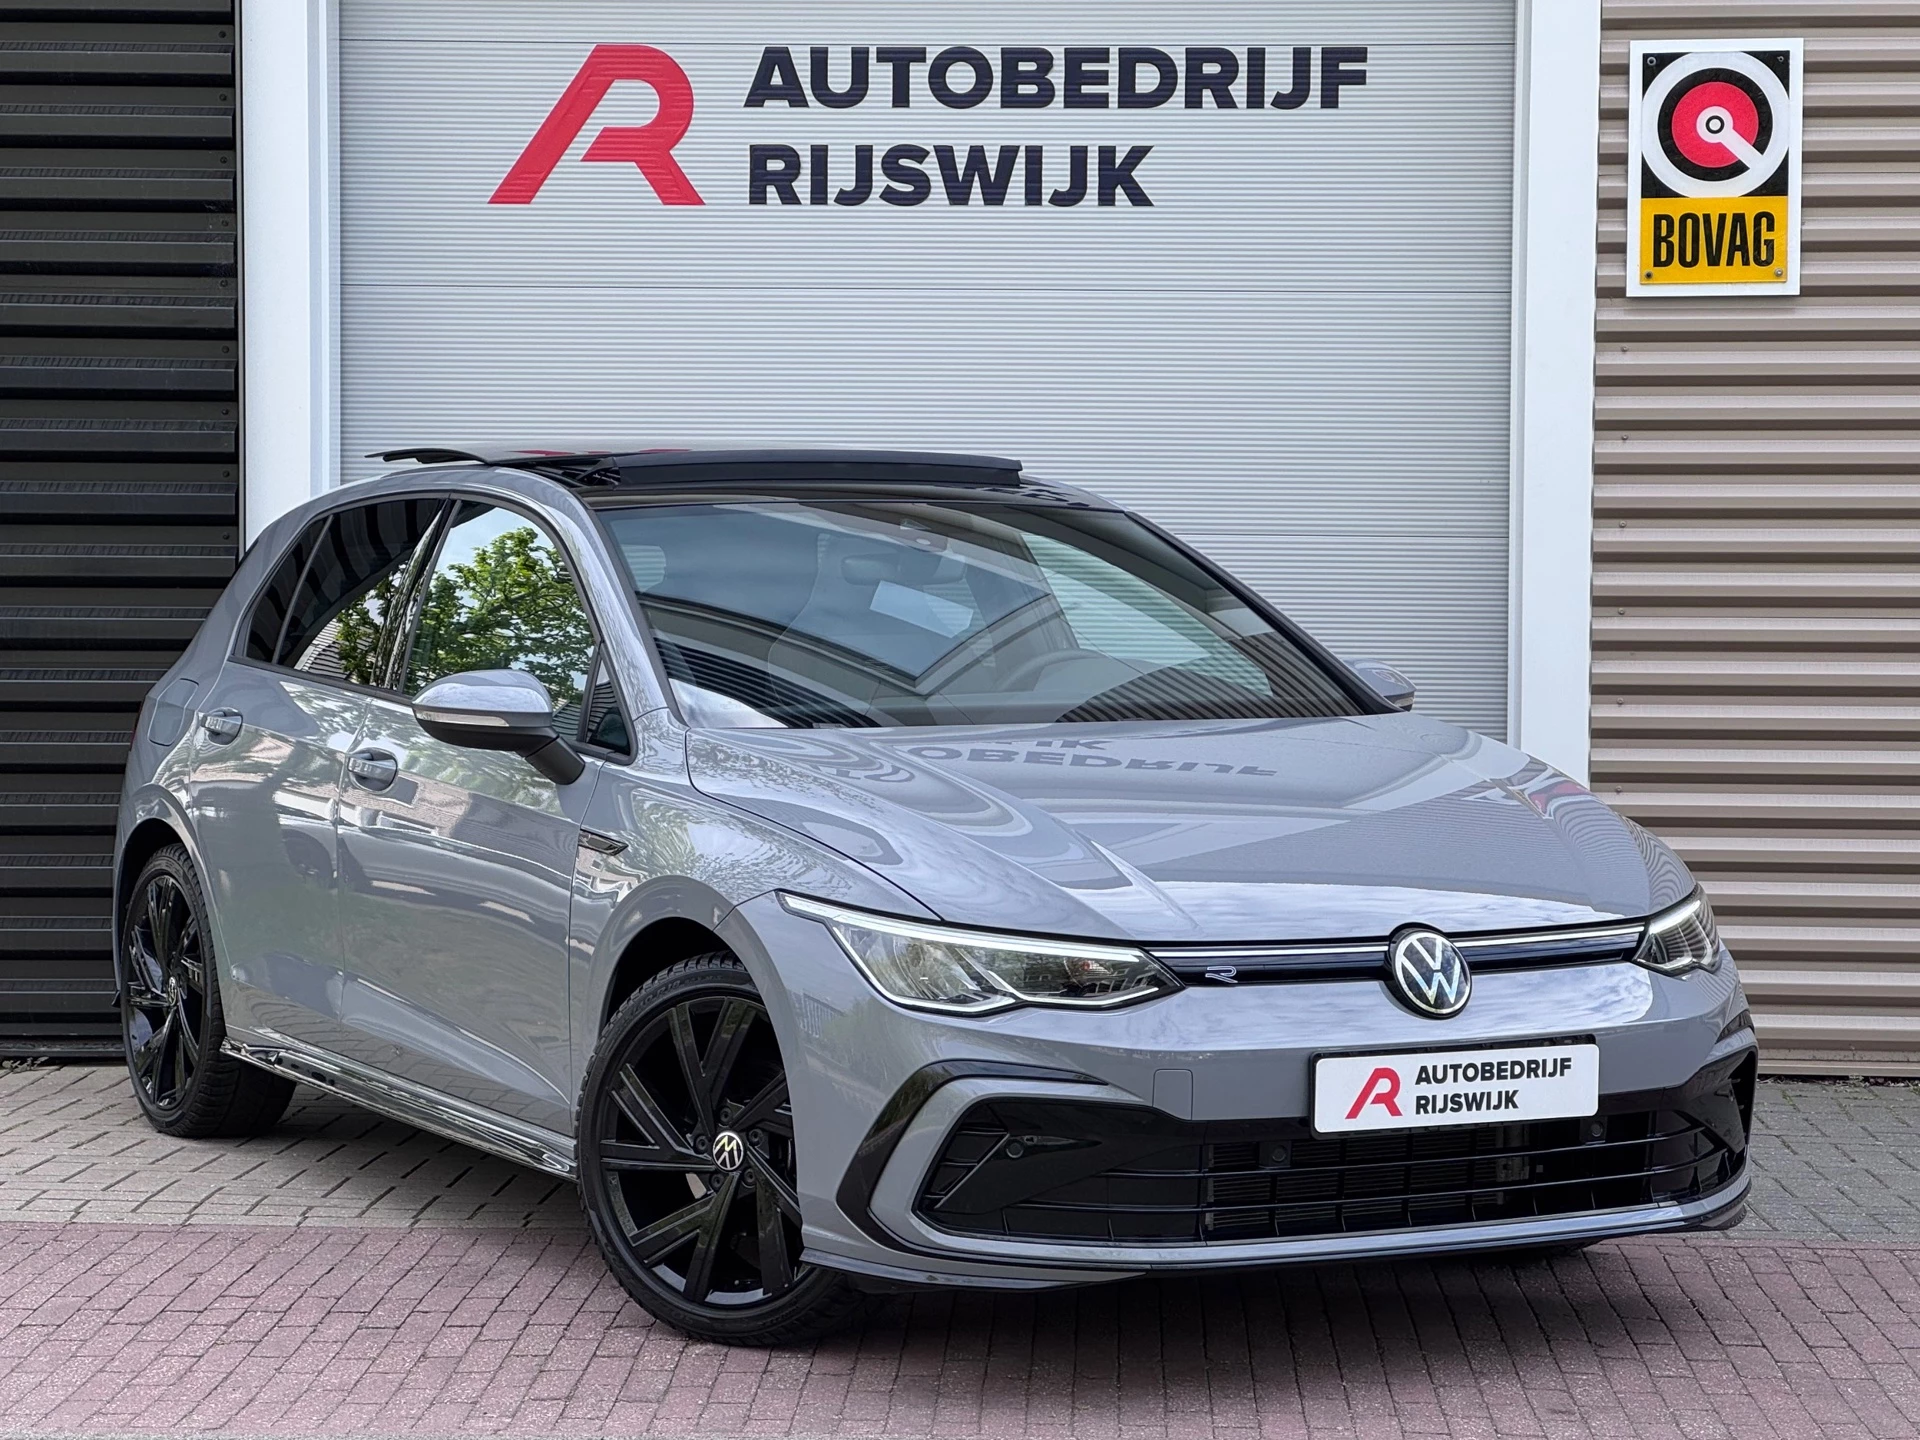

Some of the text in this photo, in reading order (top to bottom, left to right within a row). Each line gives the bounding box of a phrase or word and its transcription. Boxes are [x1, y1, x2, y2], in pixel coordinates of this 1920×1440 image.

[744, 46, 1367, 110] AUTOBEDRIJF
[749, 144, 1154, 207] RIJSWIJK
[1653, 211, 1775, 268] BOVAG
[1415, 1057, 1572, 1086] AUTOBEDRIJF
[1415, 1089, 1519, 1115] RIJSWIJK
